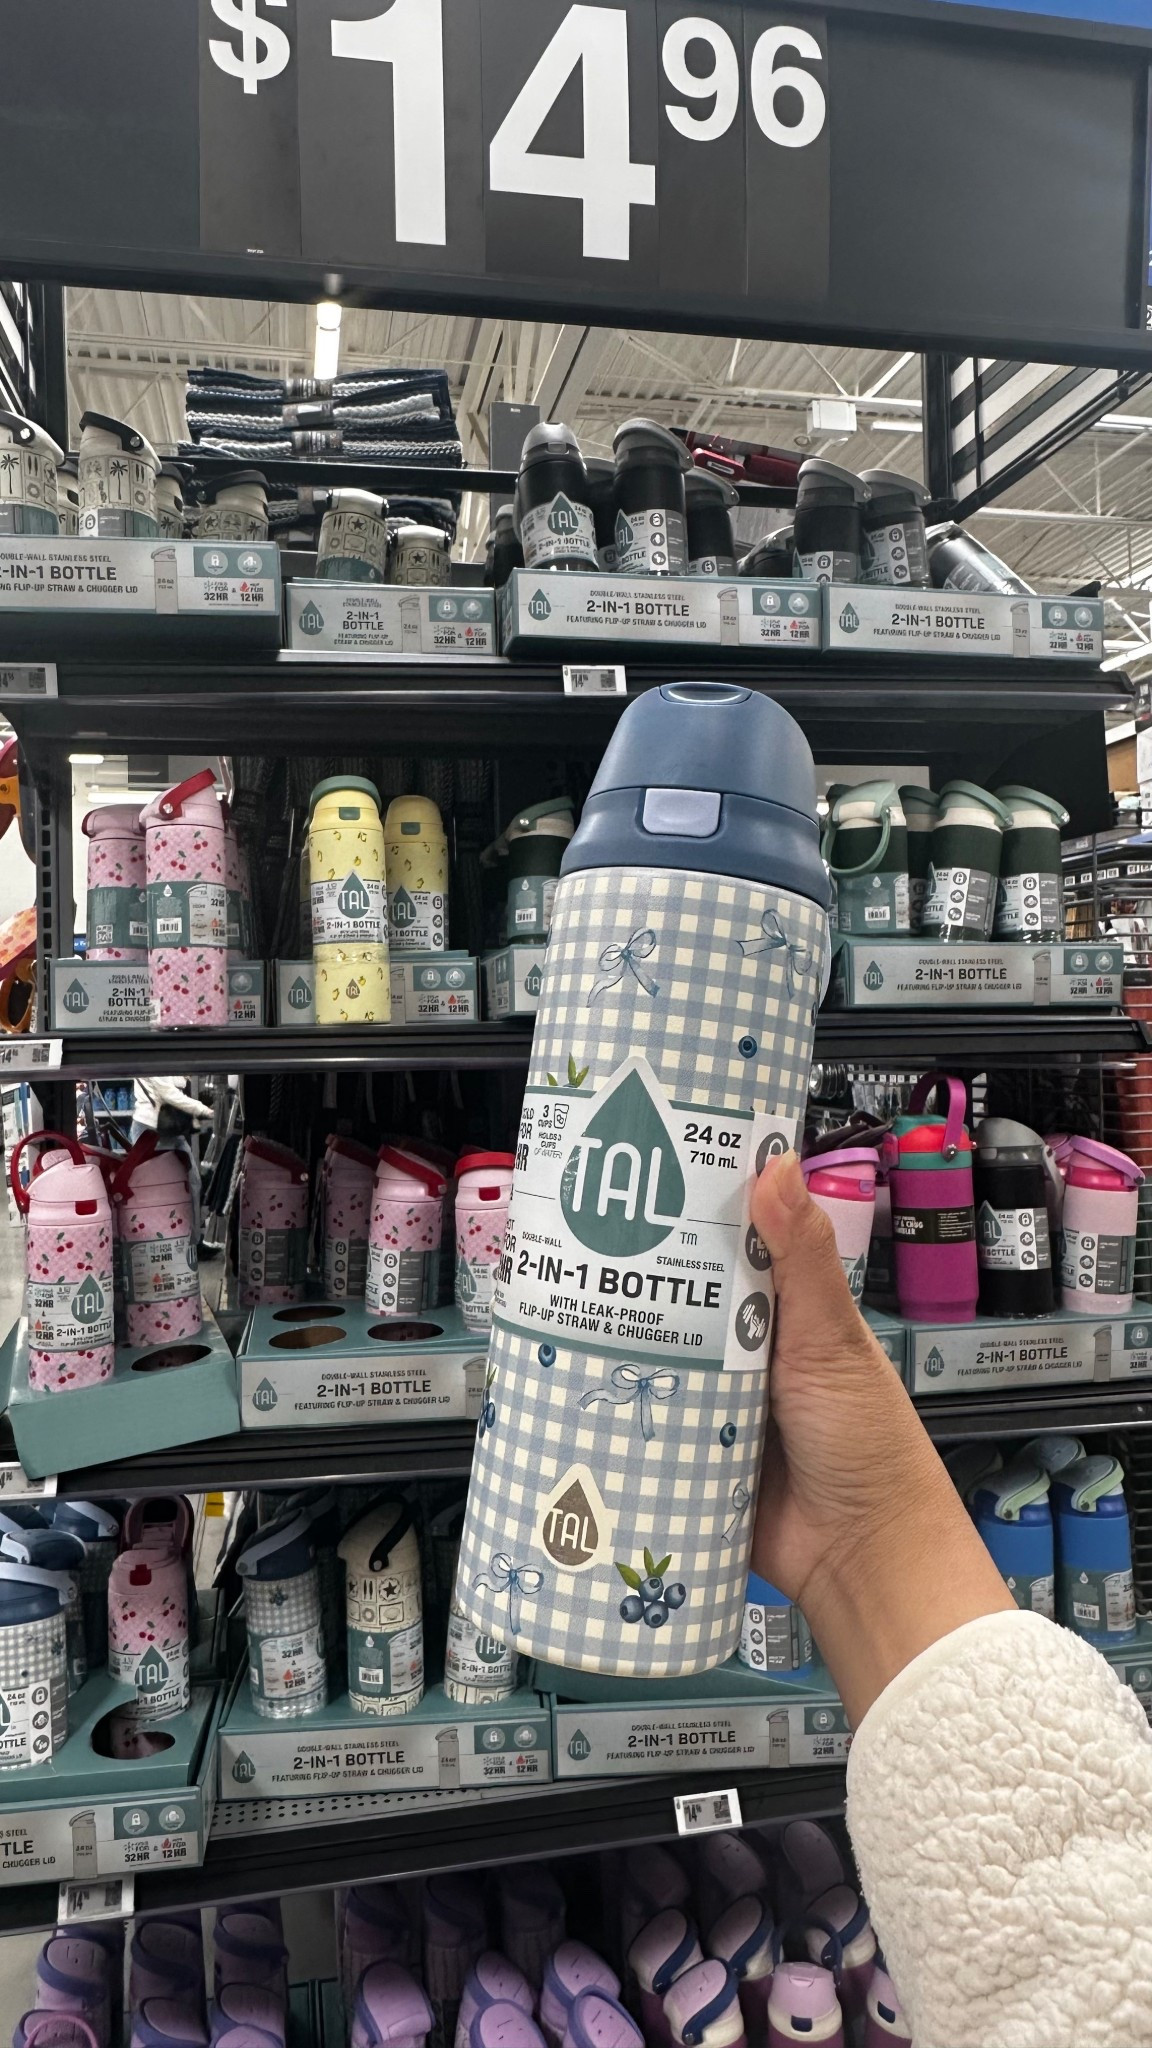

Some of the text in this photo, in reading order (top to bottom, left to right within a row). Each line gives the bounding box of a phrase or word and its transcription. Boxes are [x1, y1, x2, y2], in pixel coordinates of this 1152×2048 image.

[550, 511, 578, 528] TAL
[0, 565, 117, 581] -IN-1 BOTTLE
[14, 583, 45, 592] FLIP-UP
[47, 584, 76, 592] STRAW
[78, 584, 84, 592] &
[86, 584, 125, 593] CHUGGER
[346, 611, 379, 620] 2-IN-1
[529, 601, 552, 614] TAL
[586, 600, 689, 617] 2-IN-1 BOTTLE
[300, 613, 325, 629] TAL
[342, 621, 384, 630] BOTTLE
[891, 614, 985, 629] 2-IN-1 BOTTLE
[339, 890, 370, 910] TAL
[326, 921, 380, 930] 2-IN-1 BOTTLE
[864, 972, 883, 984] TAL
[915, 968, 1007, 980] 2-IN-1 BOTTLE
[65, 992, 89, 1007] TAL
[112, 987, 146, 996] 2-IN-1
[289, 989, 312, 1003] TAL
[108, 997, 150, 1007] BOTTLE
[543, 1105, 549, 1117] 3
[538, 1120, 552, 1128] CUPS
[683, 1123, 742, 1148] 24 oz
[690, 1151, 738, 1169] 710 mL
[571, 1135, 677, 1229] TAL
[522, 1232, 562, 1248] DOUBLE-WALL
[656, 1256, 725, 1272] STAINLESS STEEL
[517, 1250, 722, 1308] 2-IN-1 BOTTLE
[75, 1294, 104, 1316] TAL
[550, 1294, 664, 1326] WITH LEAK-PROOF
[56, 1327, 85, 1337] 2-IN-1
[519, 1302, 703, 1346] FLIP-UP STRAW & CHUGGER LID
[976, 1347, 1068, 1364] 2-IN-1 BOTTLE
[317, 1380, 432, 1397] 2-IN-1 BOTTLE
[254, 1391, 278, 1405] TAL
[548, 1508, 597, 1553] TAL
[138, 1665, 165, 1685] TAL
[150, 1687, 180, 1706] BOTTLE
[628, 1731, 736, 1748] 2-IN-1 BOTTLE
[293, 1751, 405, 1770] 2-IN-1 BOTTLE
[3, 1856, 56, 1868] CHUGGER LID
